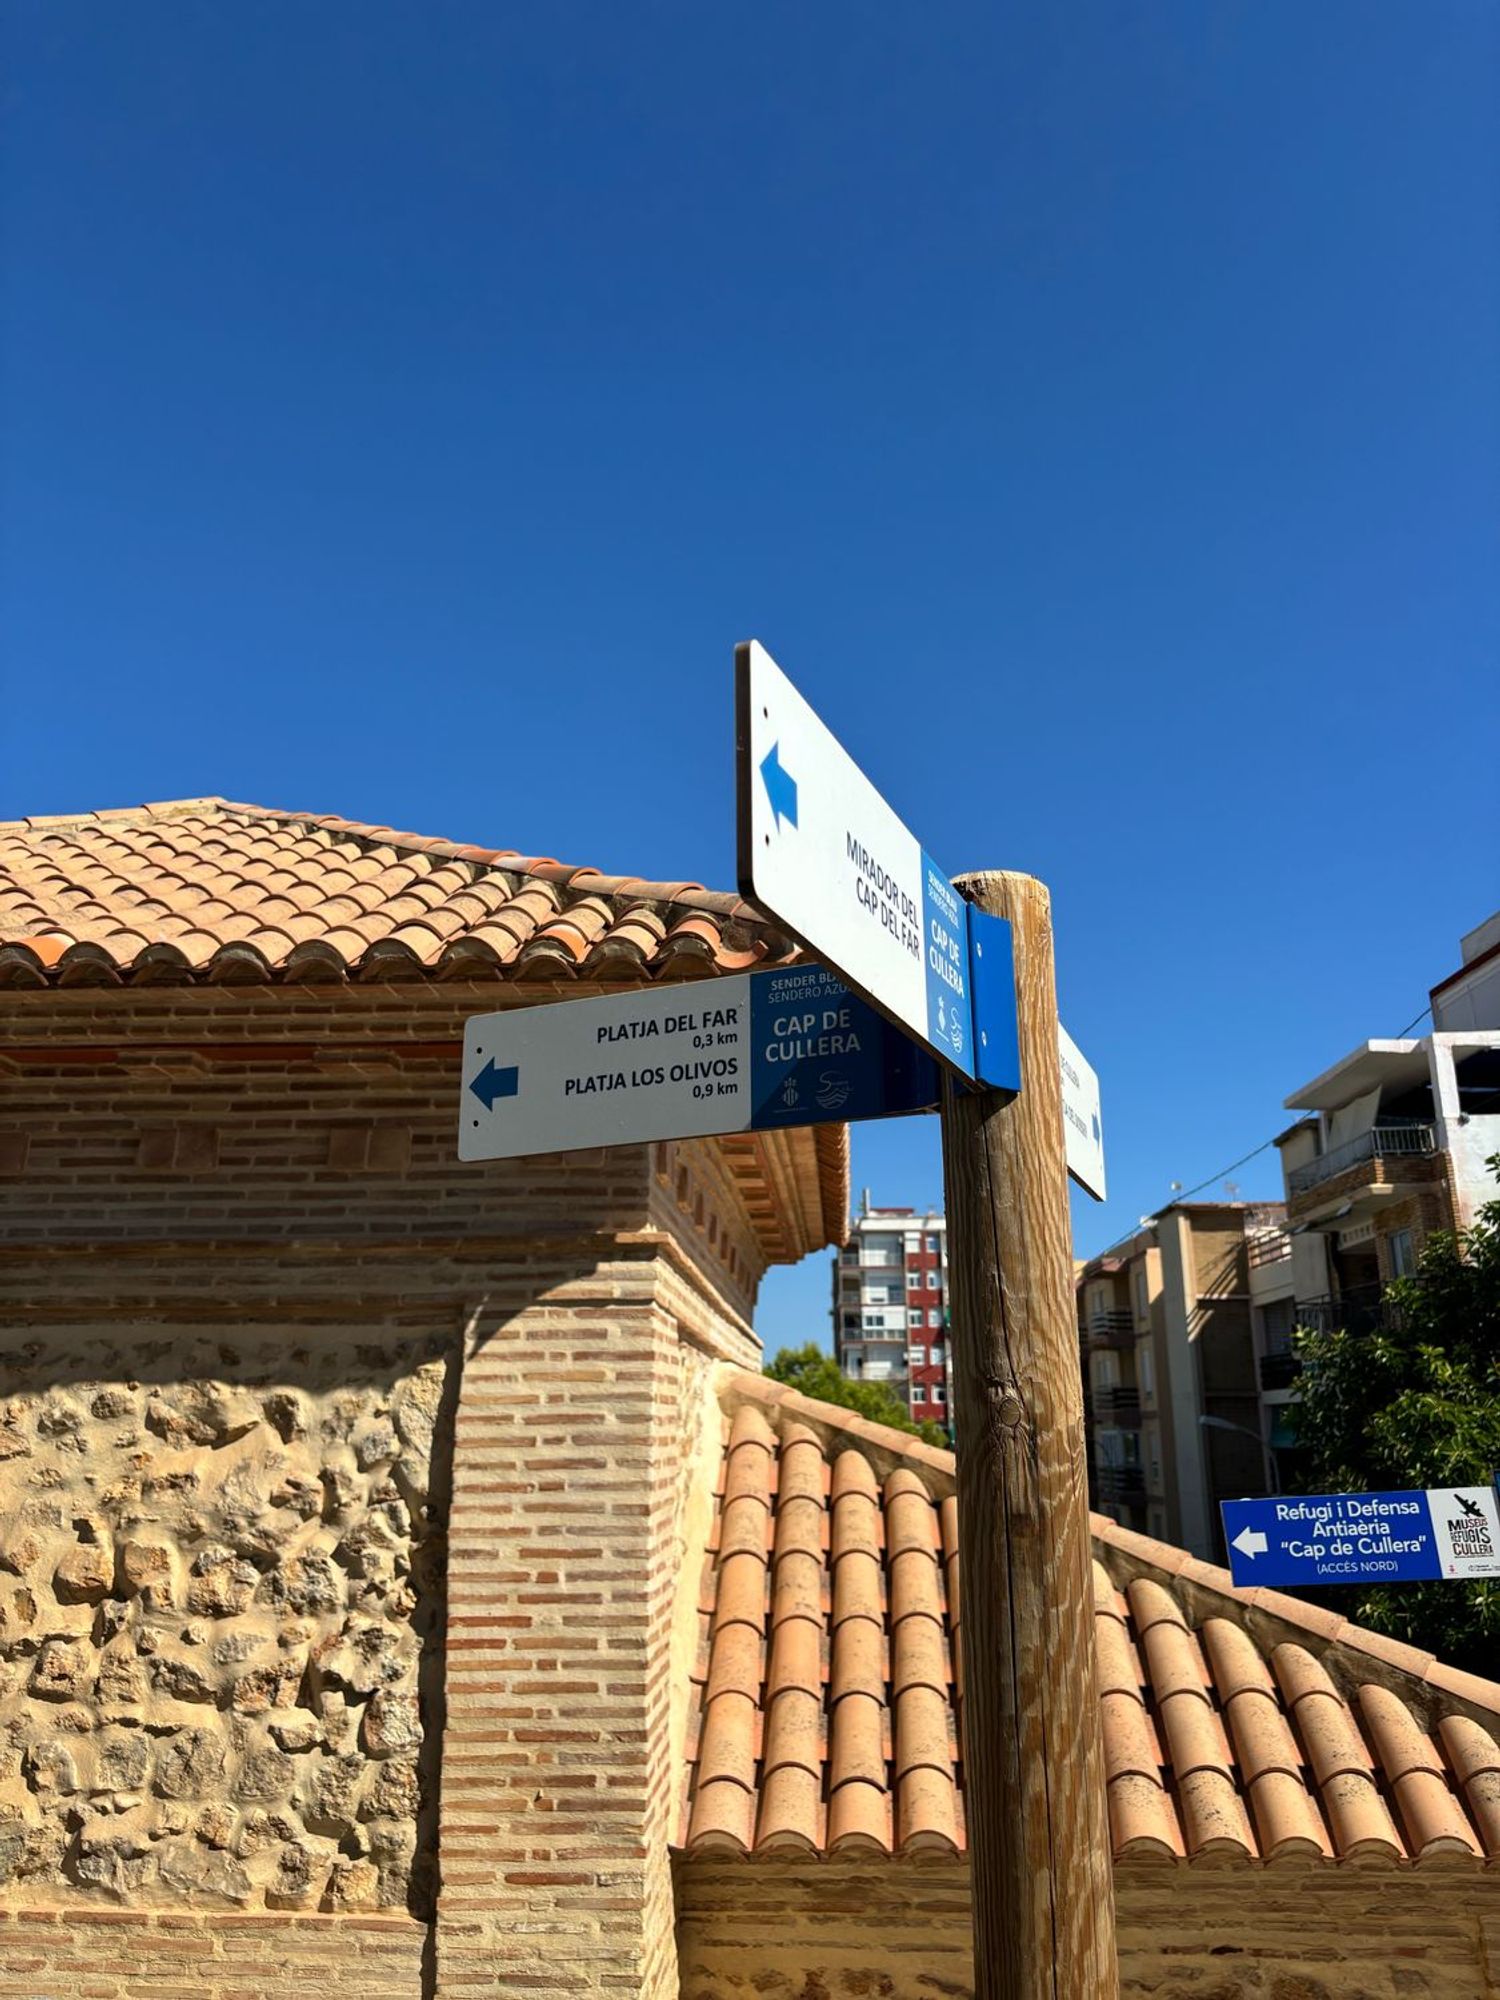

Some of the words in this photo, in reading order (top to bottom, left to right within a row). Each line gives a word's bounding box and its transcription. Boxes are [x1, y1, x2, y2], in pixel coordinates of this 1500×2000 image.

[846, 830, 900, 908] MIRADOR
[901, 892, 920, 930] DEL
[856, 877, 877, 916] CAP
[881, 901, 900, 943] DEL
[901, 922, 921, 961] FAR
[931, 918, 949, 954] CAP
[949, 935, 961, 968] DE
[771, 974, 816, 991] SENDER
[819, 971, 839, 984] BL
[929, 948, 965, 999] CULLERA
[768, 986, 821, 1004] SENDERO
[824, 983, 851, 996] AZU
[597, 1019, 659, 1044] PLATJA
[664, 1014, 697, 1034] DEL
[702, 1008, 738, 1029] FAR
[773, 1014, 816, 1037] CAP
[822, 1009, 851, 1031] DE
[693, 1033, 713, 1049] 0,3
[717, 1032, 738, 1045] km
[765, 1033, 861, 1062] CULLERA
[565, 1072, 626, 1095] PLATJA
[632, 1067, 664, 1087] LOS
[670, 1057, 738, 1082] OLIVOS
[693, 1084, 713, 1099] 0,9
[717, 1082, 738, 1095] km
[1276, 1504, 1333, 1523] Refugi
[1337, 1502, 1343, 1518] i
[1347, 1499, 1420, 1518] Defensa
[1312, 1520, 1390, 1538] Antiaèria
[1447, 1517, 1489, 1532] MUSEUS
[1335, 1539, 1354, 1556] de
[1452, 1543, 1495, 1556] CULLERA
[1360, 1561, 1399, 1573] NORD)
